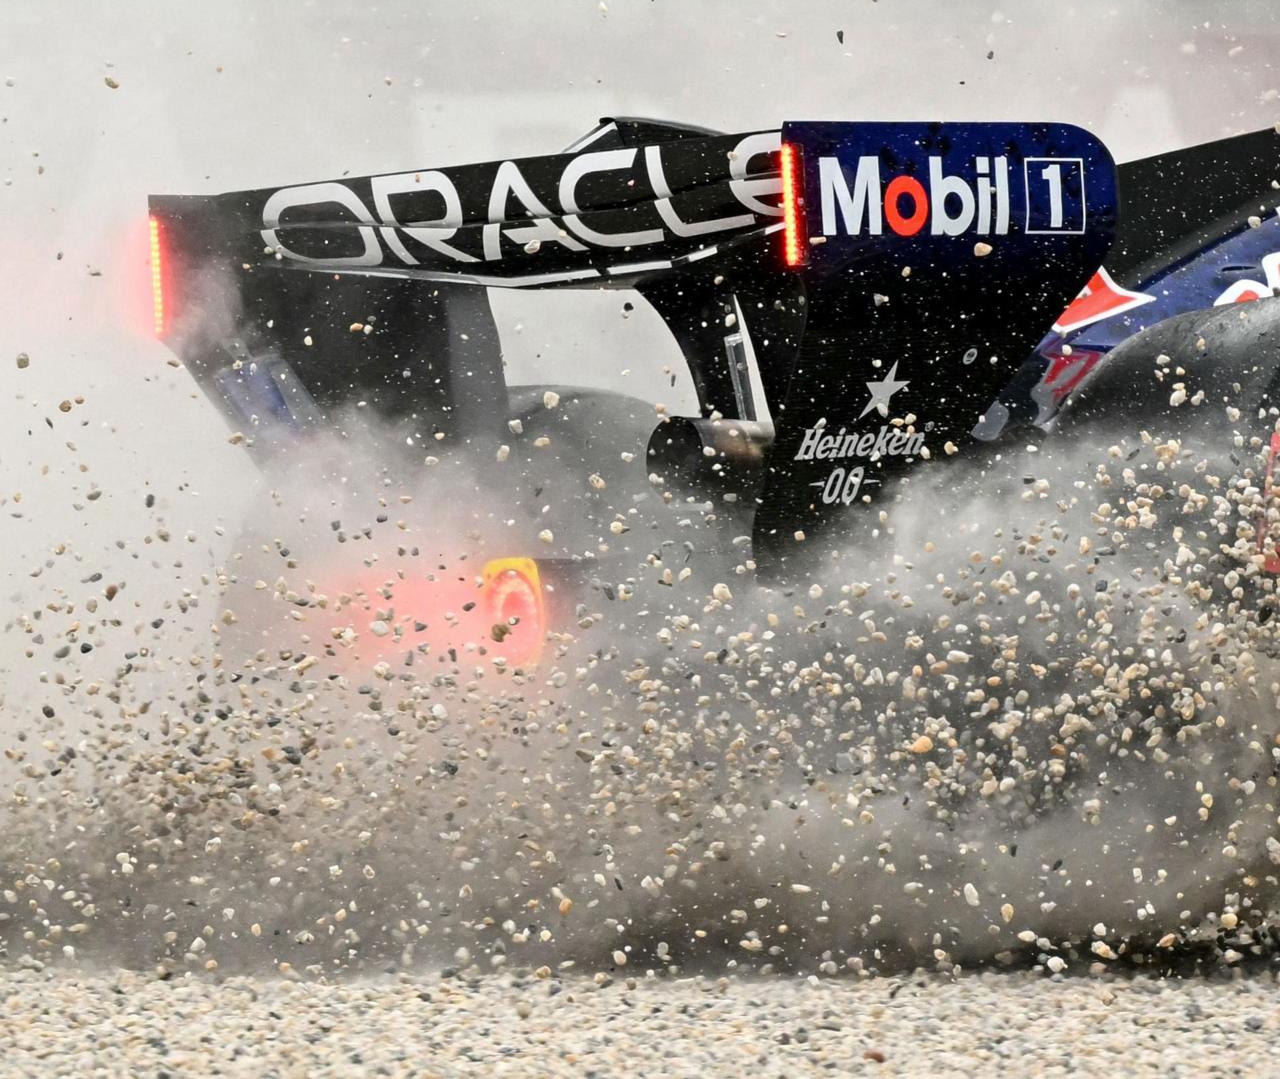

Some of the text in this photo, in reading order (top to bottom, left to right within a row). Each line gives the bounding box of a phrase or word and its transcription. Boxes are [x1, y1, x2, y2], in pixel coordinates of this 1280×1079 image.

[261, 132, 784, 266] ORACLE
[818, 155, 1009, 237] Mobil
[793, 425, 926, 461] Heineken
